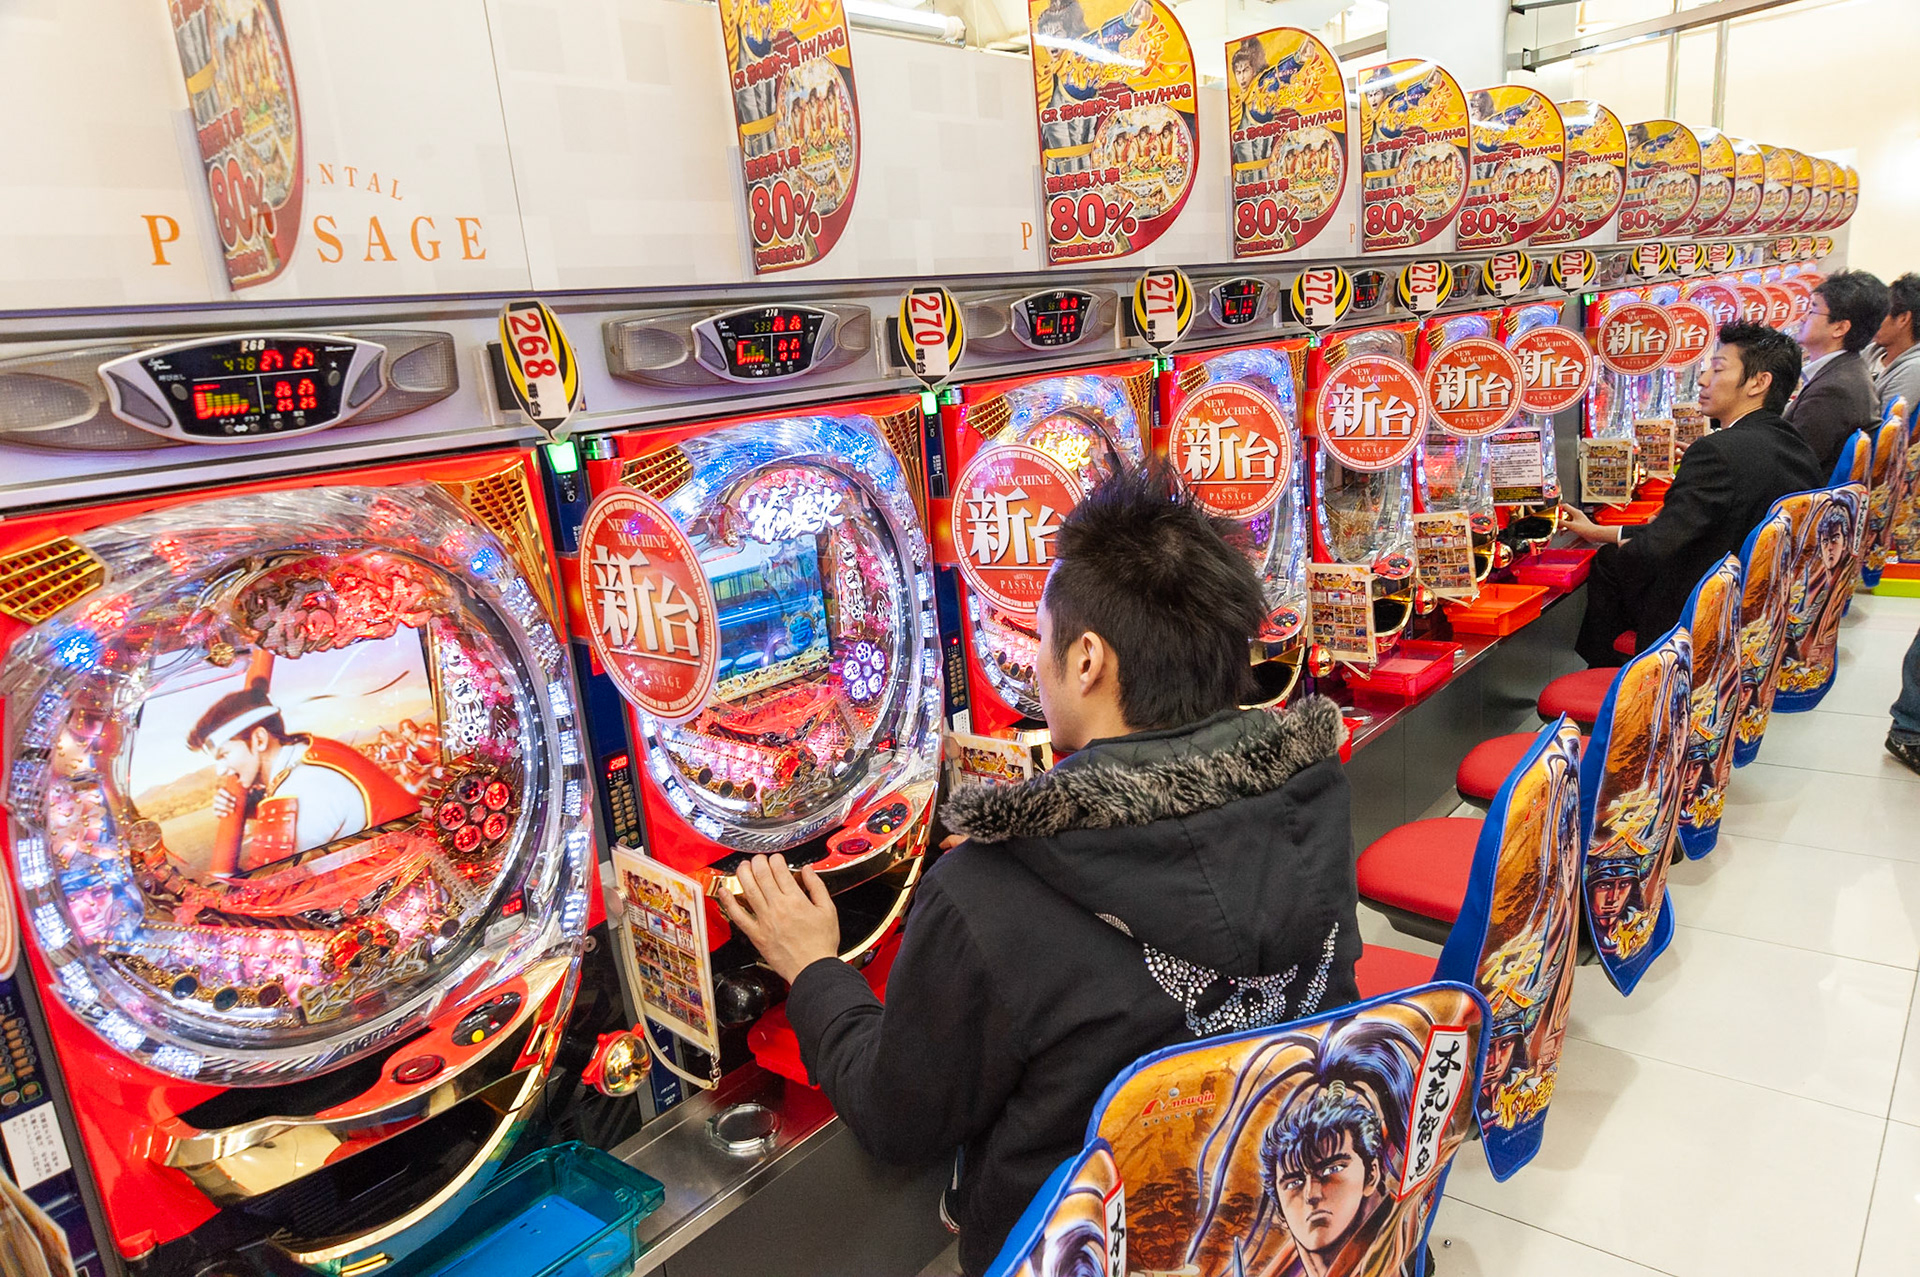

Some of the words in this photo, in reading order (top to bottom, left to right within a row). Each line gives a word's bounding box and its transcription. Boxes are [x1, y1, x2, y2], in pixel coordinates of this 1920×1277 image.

[1041, 109, 1058, 123] CR
[1046, 167, 1120, 193] 確変突入率
[752, 180, 820, 245] 80%
[1050, 193, 1137, 241] 80%
[1237, 199, 1300, 239] 80%
[1366, 202, 1425, 234] 80%
[1459, 207, 1518, 237] 80%
[1620, 209, 1665, 230] 80%
[1562, 252, 1583, 275] 276
[1641, 246, 1659, 265] 277
[1677, 245, 1695, 265] 278
[1710, 244, 1727, 264] 280
[1412, 265, 1437, 294] 273
[1493, 255, 1518, 283] 275
[1146, 277, 1176, 314] 271
[1306, 272, 1334, 306] 272
[754, 321, 771, 333] 533
[910, 296, 945, 345] 270
[241, 339, 265, 353] 268
[509, 313, 557, 379] 268
[1531, 335, 1549, 343] NEW
[1537, 340, 1572, 348] MACHINE
[1606, 320, 1668, 355] 新台
[223, 357, 255, 371] 478
[260, 349, 284, 371] 27
[292, 347, 315, 368] 27
[1454, 350, 1472, 358] NEW
[1460, 354, 1499, 364] MACHINE
[1351, 368, 1371, 376] NEW
[1518, 347, 1584, 388] 新台
[1358, 374, 1401, 383] MACHINE
[1435, 363, 1513, 410] 新台
[1204, 399, 1226, 408] NEW
[1212, 405, 1260, 417] MACHINE
[1328, 383, 1416, 437] 新台
[1181, 416, 1279, 480] 新台
[988, 465, 1013, 476] NEW
[998, 475, 1052, 487] MACHINE
[1209, 492, 1254, 501] PASSAGE
[606, 518, 630, 532] NEW
[617, 532, 670, 550] MACHINE
[1000, 579, 1044, 591] PASSAG
[590, 544, 700, 657] 新台
